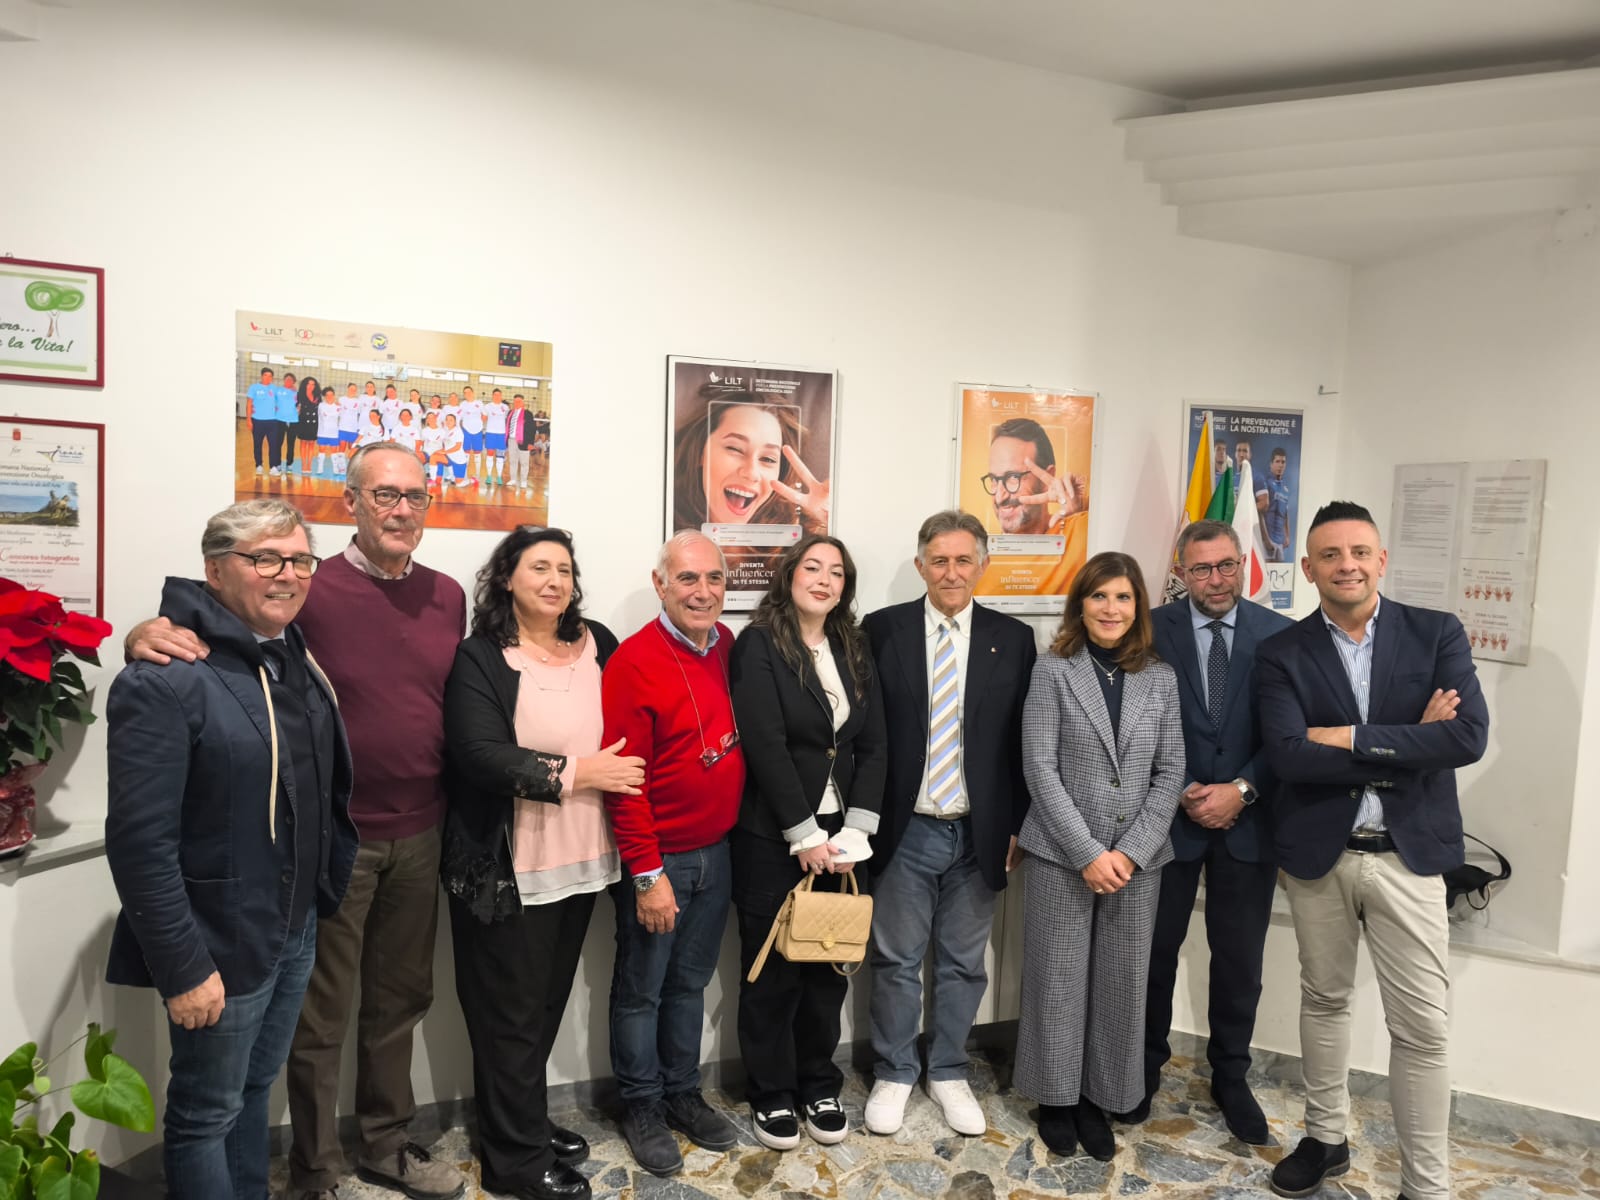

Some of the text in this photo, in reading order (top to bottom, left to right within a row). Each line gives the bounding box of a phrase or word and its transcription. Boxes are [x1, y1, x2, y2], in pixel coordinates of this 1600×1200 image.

[0, 322, 35, 332] ero...
[264, 328, 284, 336] LILT
[8, 336, 74, 352] la Vita!
[724, 377, 743, 385] LILT
[1003, 400, 1019, 409] LILT
[1230, 416, 1239, 425] LA
[1241, 417, 1290, 427] PREVENZIONE
[1230, 424, 1292, 436] LA NOSTRA META.
[726, 567, 776, 579] influencer
